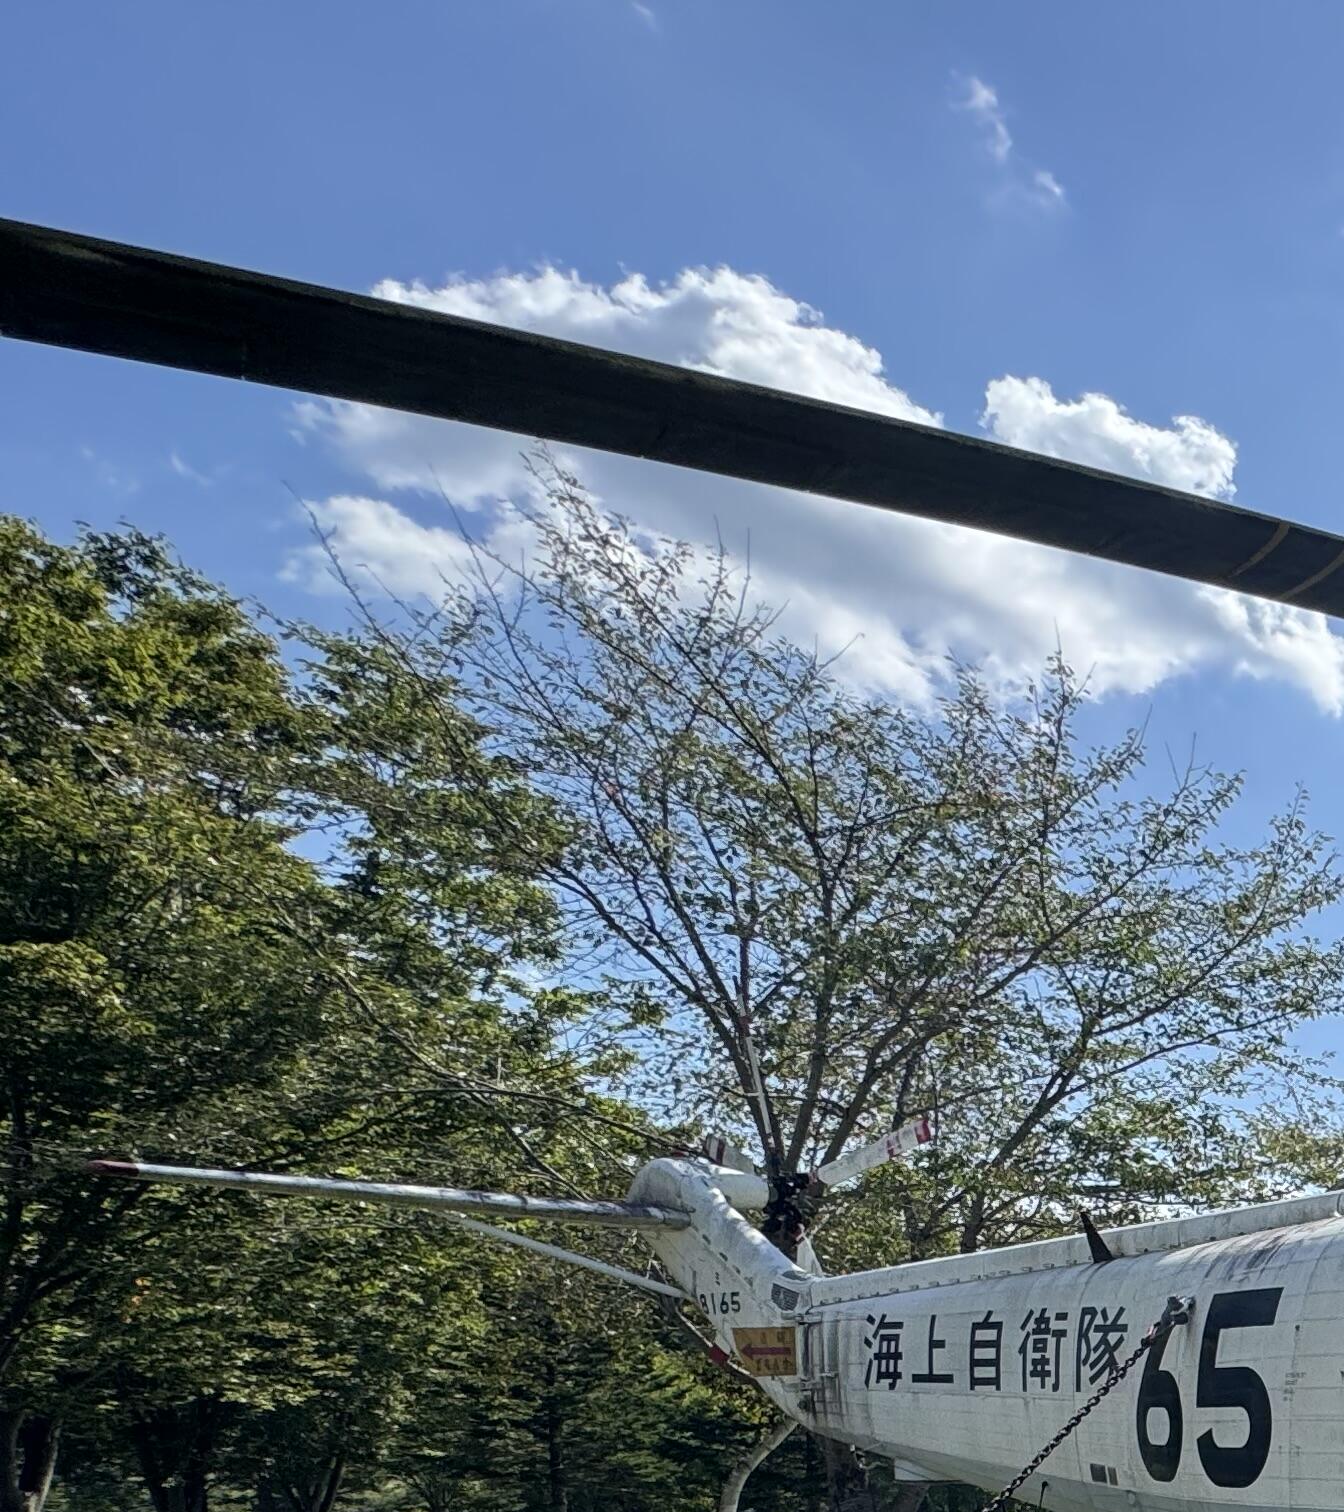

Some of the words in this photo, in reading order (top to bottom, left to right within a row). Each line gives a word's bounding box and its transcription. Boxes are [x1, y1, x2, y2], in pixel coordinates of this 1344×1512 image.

[700, 1291, 741, 1315] 8165
[864, 1306, 1129, 1393] 海上自衛隊
[1136, 1286, 1285, 1489] 65
